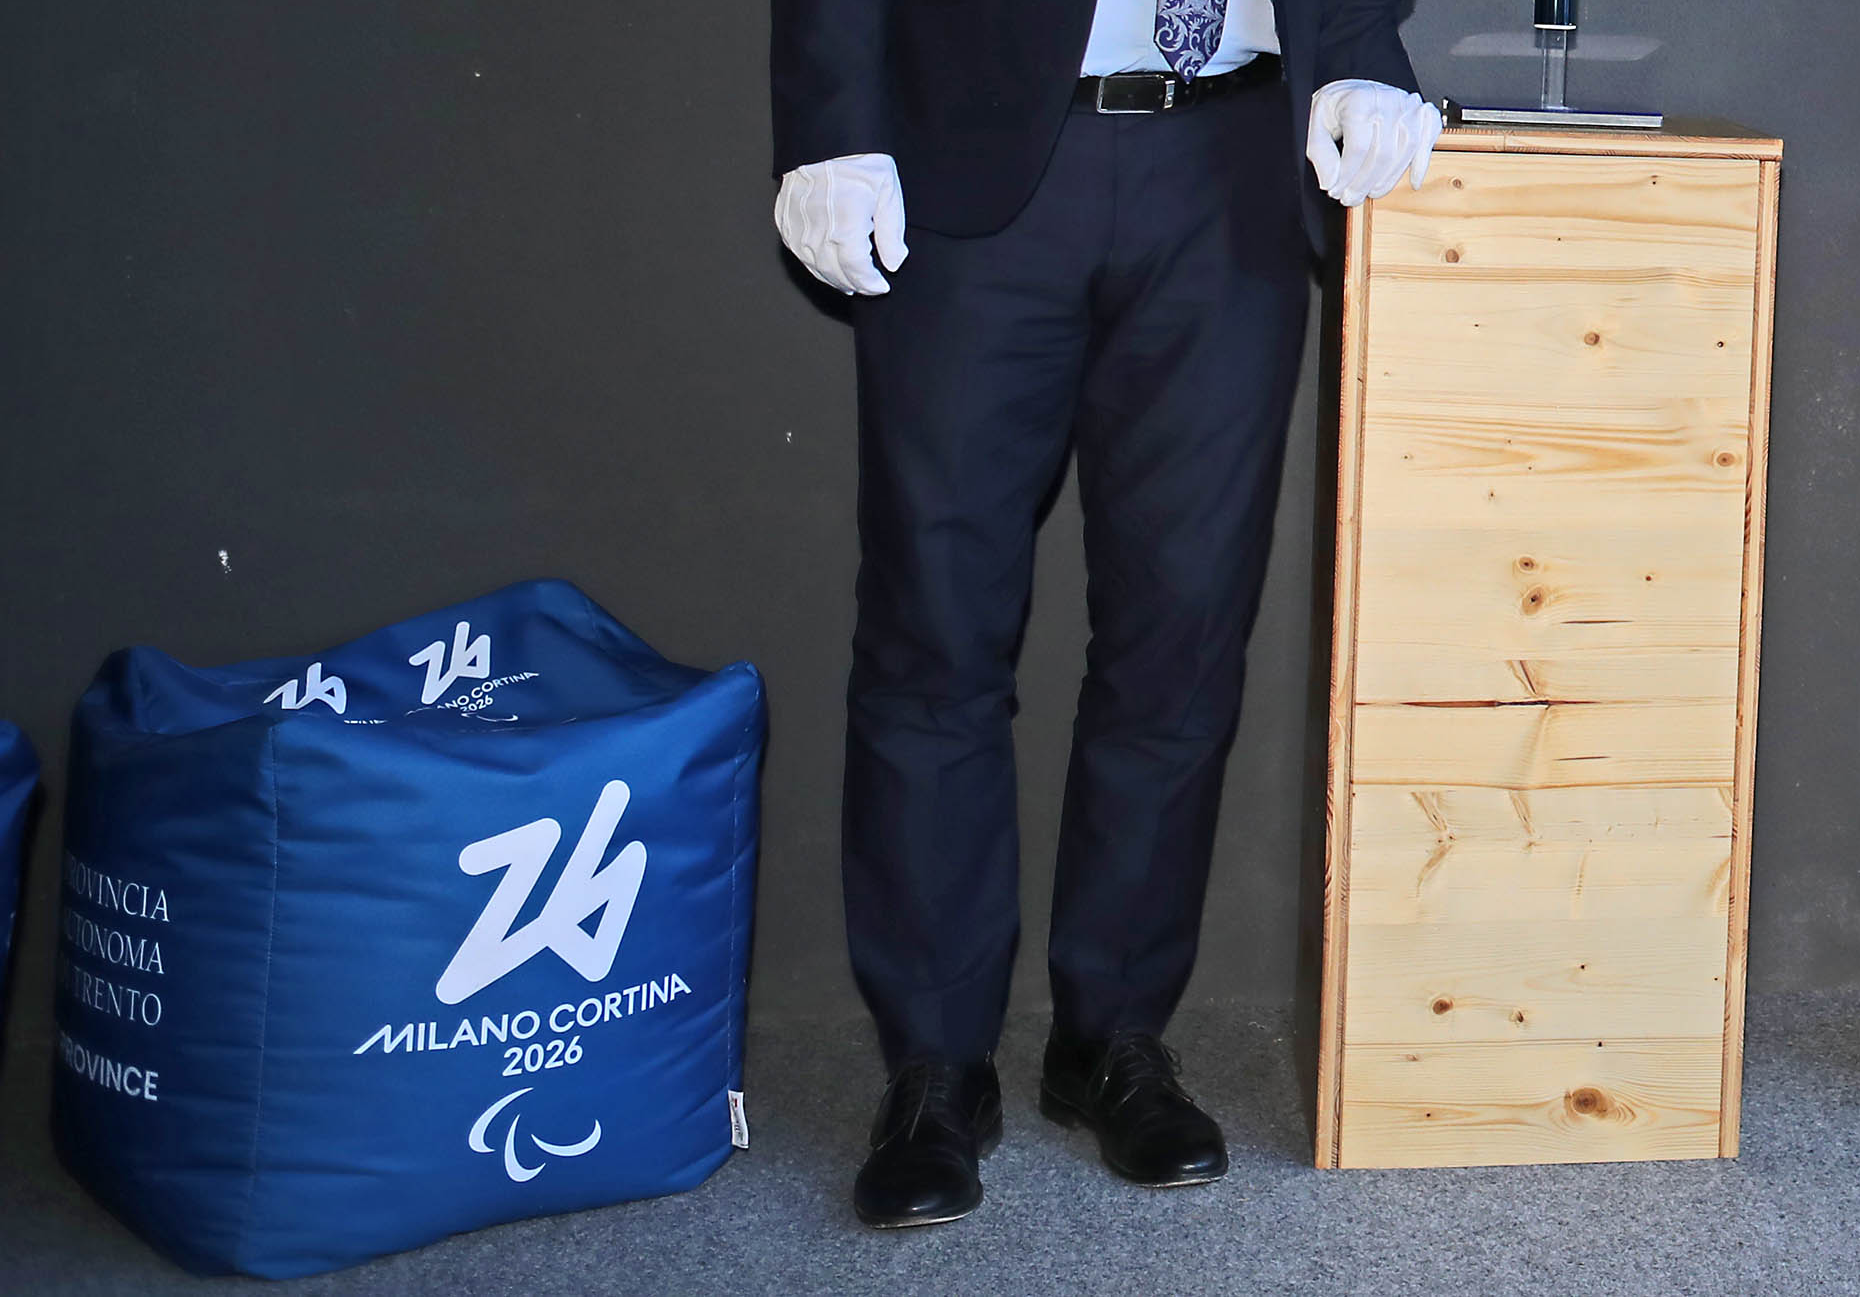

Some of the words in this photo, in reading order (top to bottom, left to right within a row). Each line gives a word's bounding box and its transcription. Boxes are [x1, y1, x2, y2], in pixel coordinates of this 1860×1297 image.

[460, 696, 494, 712] 2026
[471, 671, 540, 699] CORTINA
[66, 852, 170, 922] ROVINCIA
[435, 779, 648, 1004] 26
[74, 965, 162, 1026] TRENTO
[353, 1010, 541, 1054] MILANO
[549, 973, 692, 1033] CORTINA
[502, 1035, 584, 1077] 2026
